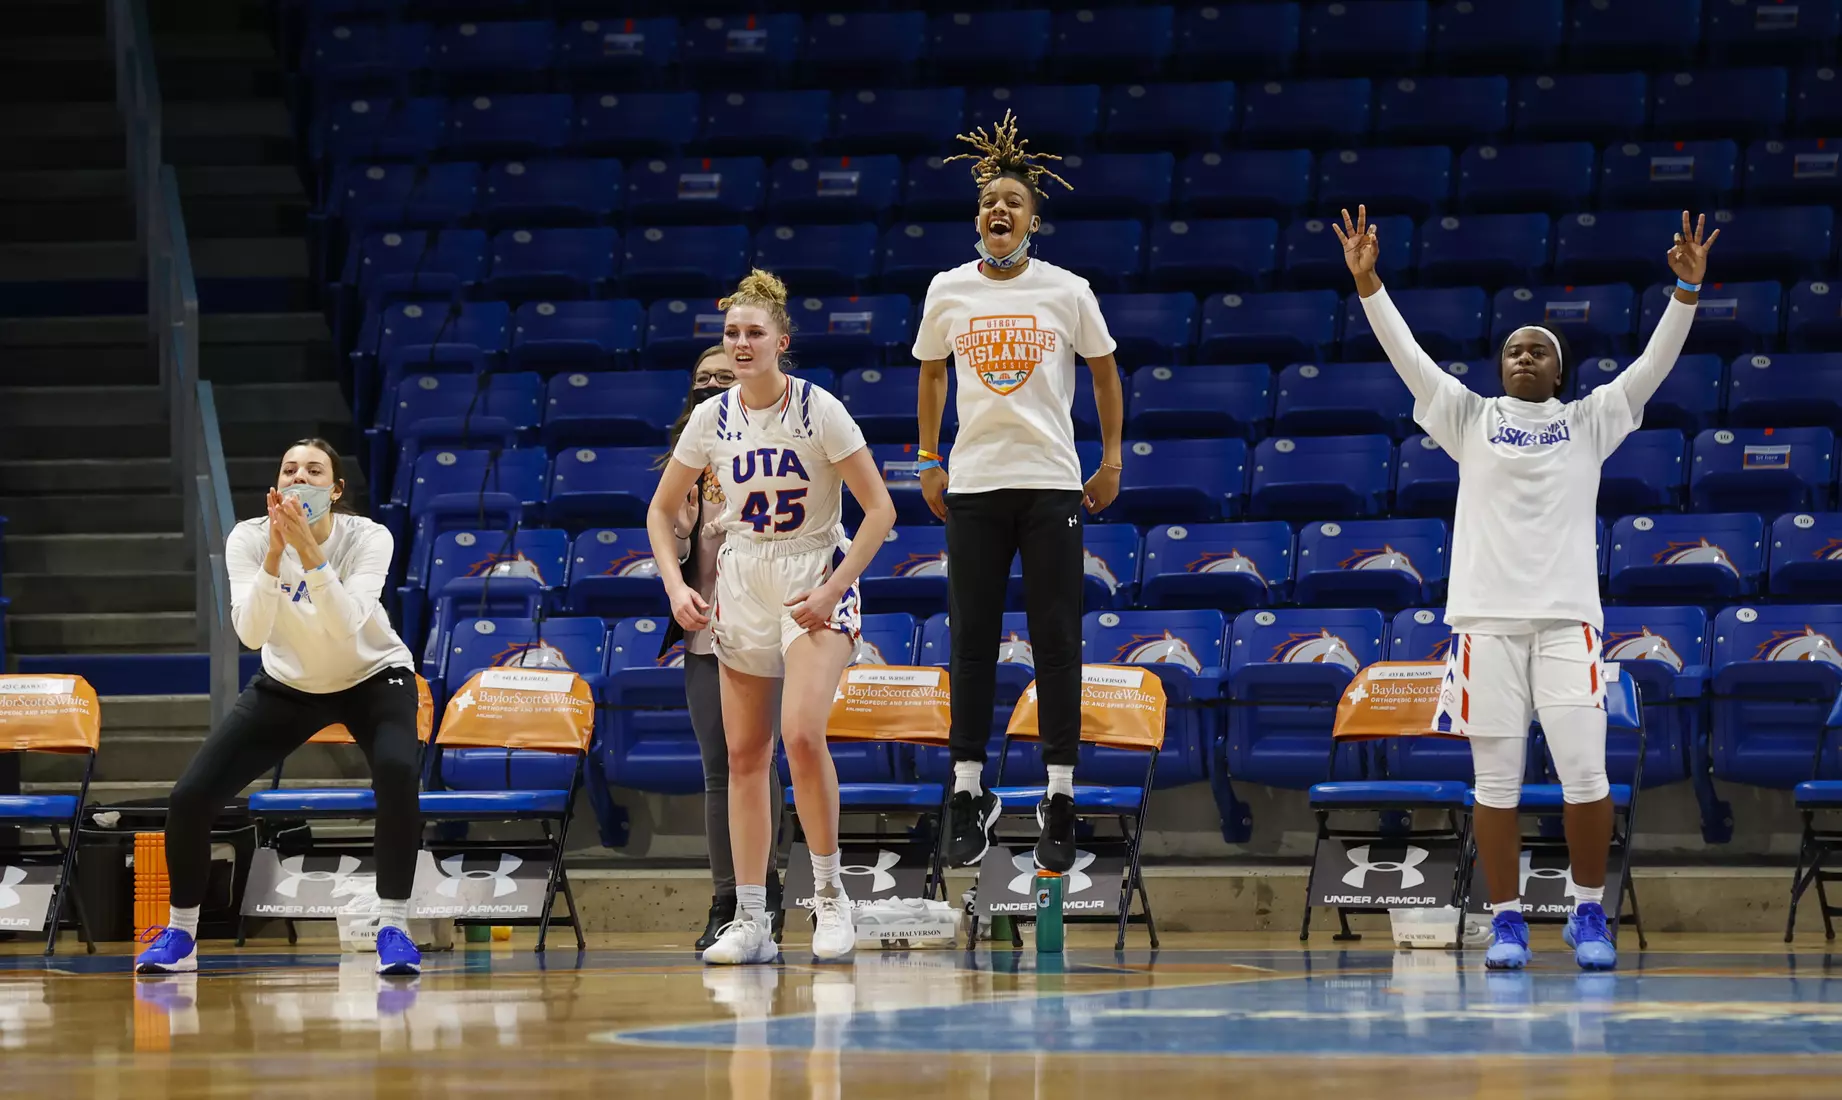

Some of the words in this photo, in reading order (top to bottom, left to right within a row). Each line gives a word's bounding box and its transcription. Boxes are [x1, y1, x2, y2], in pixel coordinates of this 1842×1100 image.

[986, 319, 1017, 329] UTRGV
[956, 329, 1001, 356] SOUTH
[1005, 329, 1056, 352] PADRE
[968, 343, 1042, 366] ISLAND
[980, 361, 1030, 371] CLASSIC
[732, 447, 810, 485] UTA
[740, 486, 808, 533] 45
[1087, 676, 1128, 684] HALVERSON
[1081, 686, 1156, 704] rScott&White
[1371, 682, 1441, 697] BaylorScott&
[0, 694, 90, 707] lorScott&White
[846, 698, 888, 706] ORTHOPEDIC
[477, 704, 519, 712] ORTHOPEDIC
[553, 707, 584, 715] HOSPITAL
[1125, 703, 1156, 712] HOSPITAL
[1036, 888, 1050, 908] G
[1323, 895, 1372, 904] UNDER
[1375, 895, 1436, 905] ARMOUR
[255, 904, 304, 914] UNDER
[416, 904, 462, 915] UNDER
[464, 904, 529, 914] ARMOUR
[989, 902, 1037, 911] UNDER
[1062, 900, 1105, 909] MOUR
[1537, 903, 1572, 913] ARM
[0, 917, 31, 926] OUR
[899, 930, 942, 938] HALVERSON
